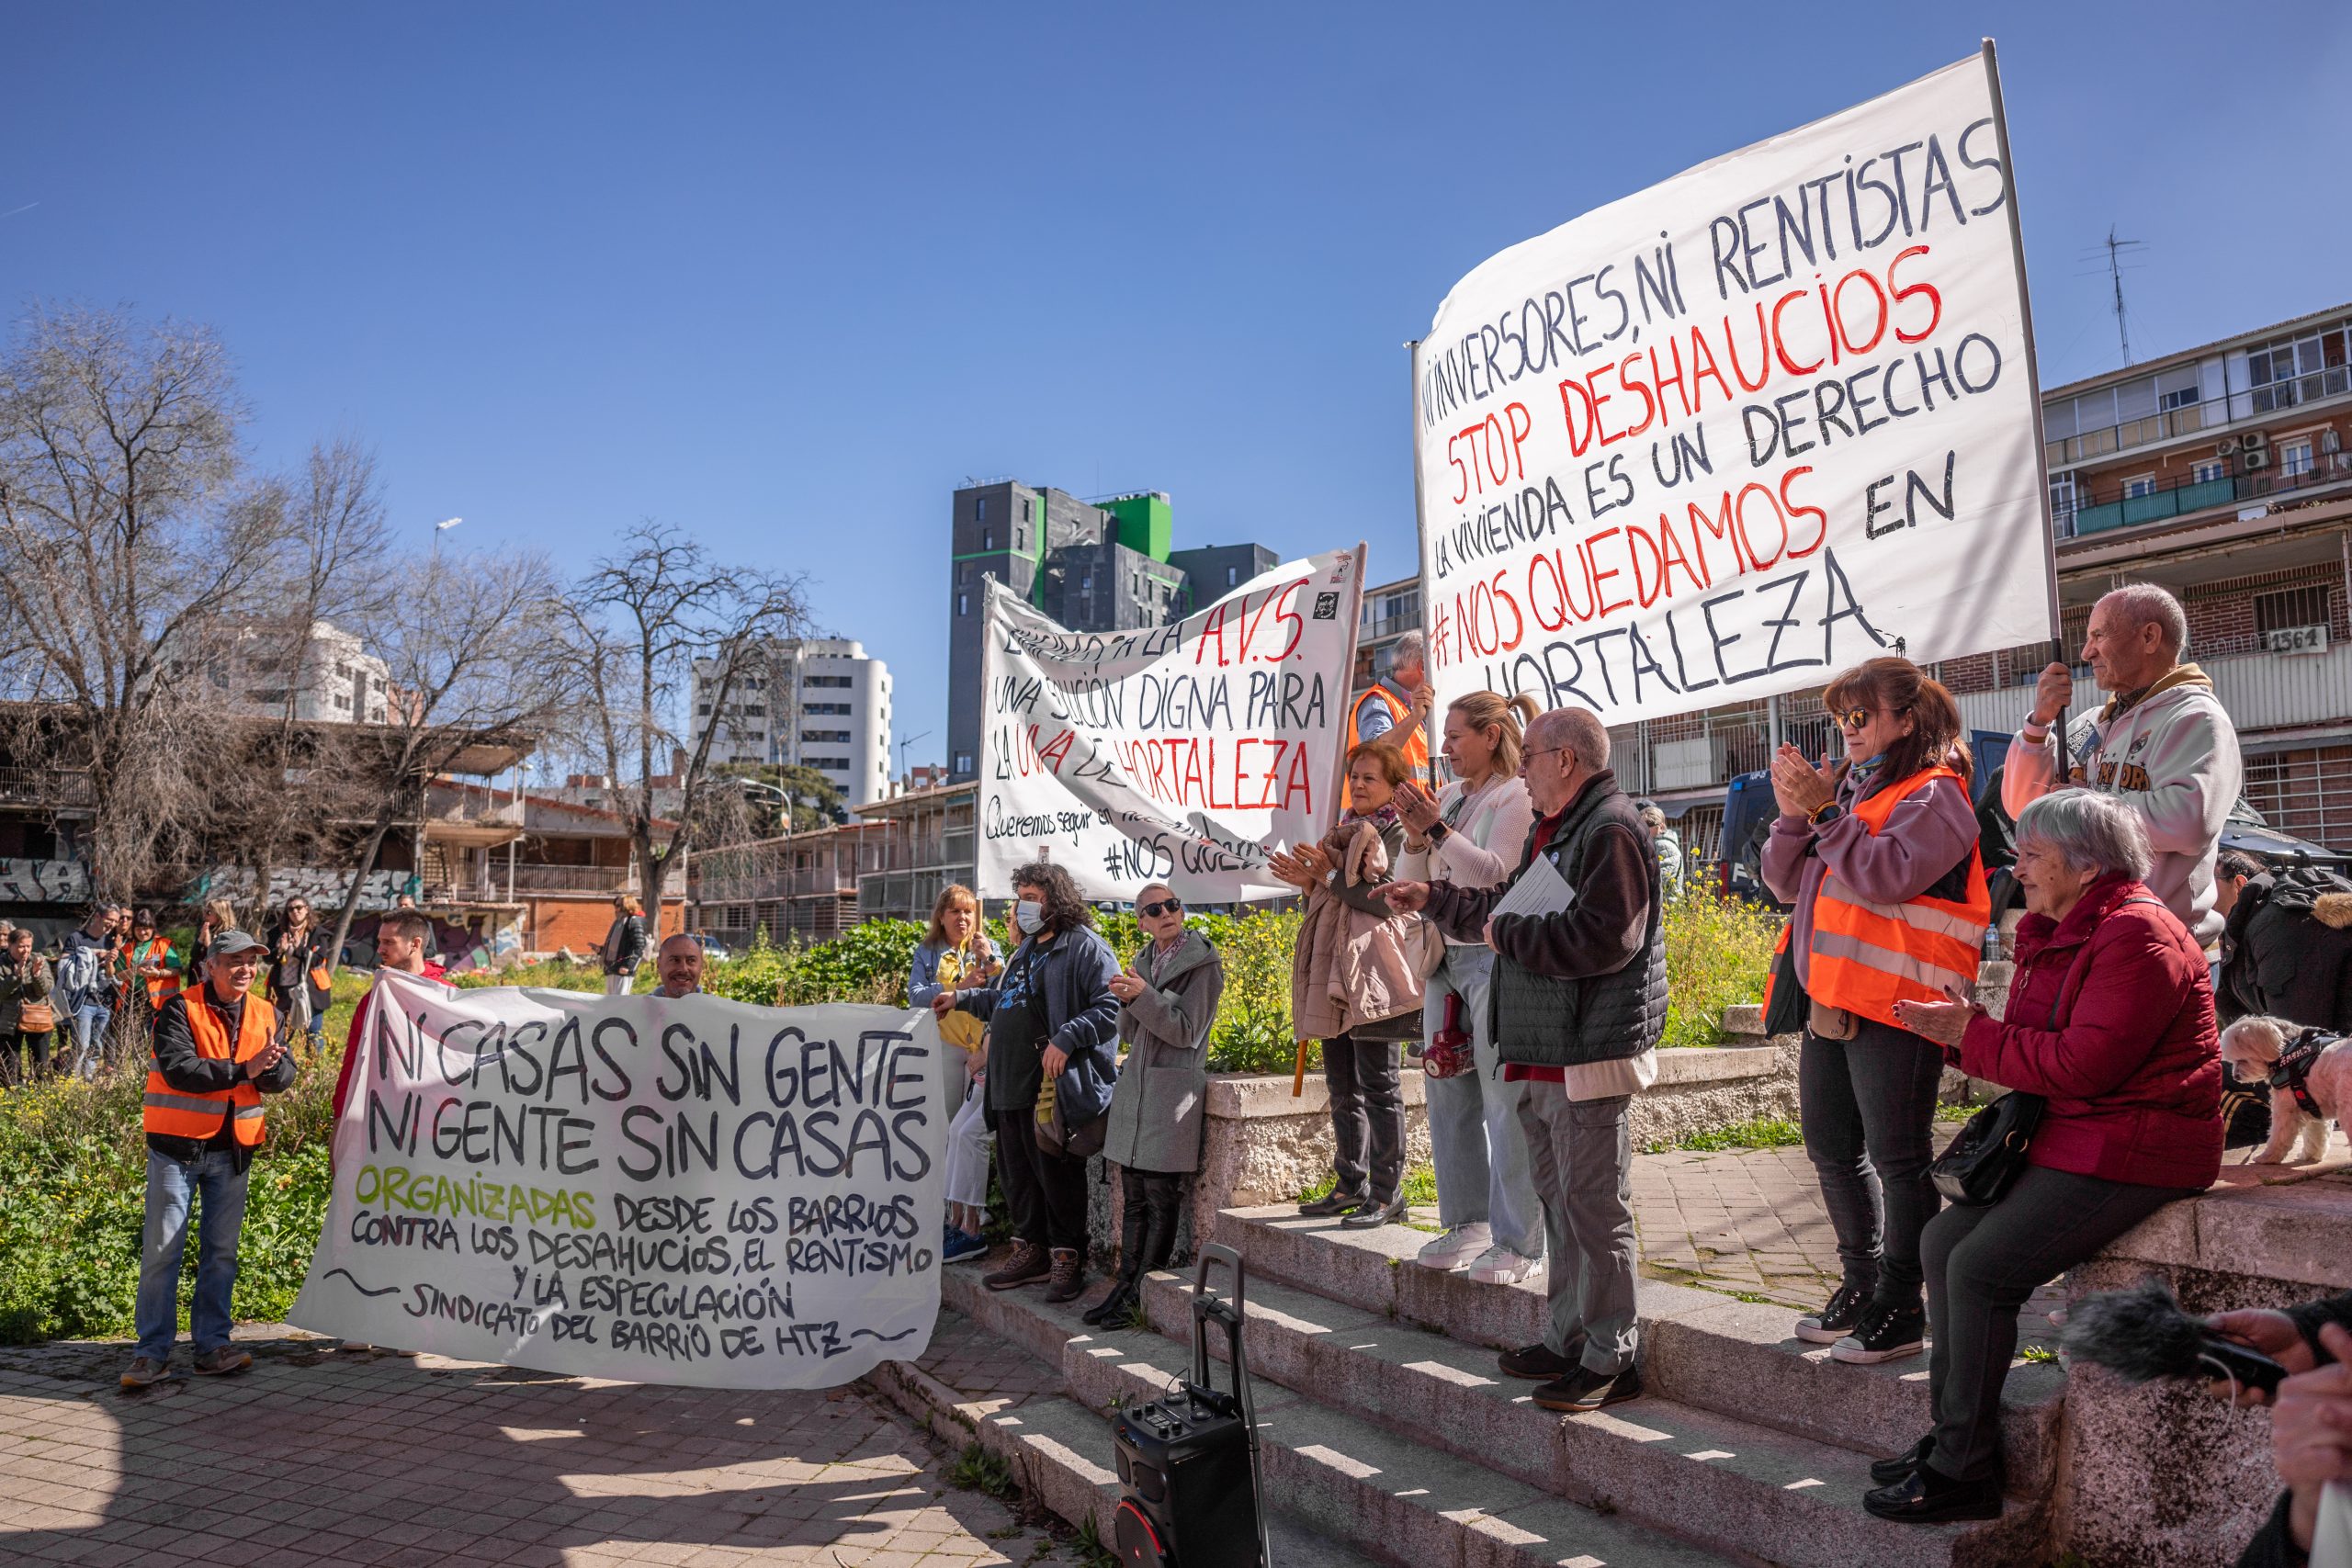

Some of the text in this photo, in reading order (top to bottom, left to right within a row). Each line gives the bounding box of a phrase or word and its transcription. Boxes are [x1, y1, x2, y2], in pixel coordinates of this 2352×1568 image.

[1436, 536, 1453, 579] LA
[1585, 454, 1634, 519] ES
[1652, 422, 1713, 488] UN
[1742, 333, 2001, 467] DERECHO
[1448, 402, 1531, 505] STOP
[1866, 449, 1955, 539] EN
[1143, 622, 1183, 656] LA
[994, 675, 1042, 715] UNA
[1247, 671, 1326, 729] PARA
[994, 725, 1016, 781] LA
[1016, 723, 1075, 777] UVA
[1114, 737, 1311, 815] HORTALEZA
[986, 795, 1056, 840] Queremos
[1057, 803, 1092, 847] seguir
[378, 1010, 929, 1110] NI CASAS SIN GENTE
[369, 1089, 931, 1182] NI GENTE SIN CASAS
[351, 1211, 460, 1254] CONTRA
[471, 1223, 518, 1260] LOS
[743, 1238, 775, 1272] EL
[614, 1193, 715, 1234] DESDE
[728, 1196, 778, 1234] LOS
[788, 1193, 919, 1239] BARRIOS
[402, 1283, 540, 1337] SINDICATO
[551, 1314, 597, 1343] DEL
[720, 1325, 764, 1359] DE
[776, 1321, 852, 1359] HTZ
